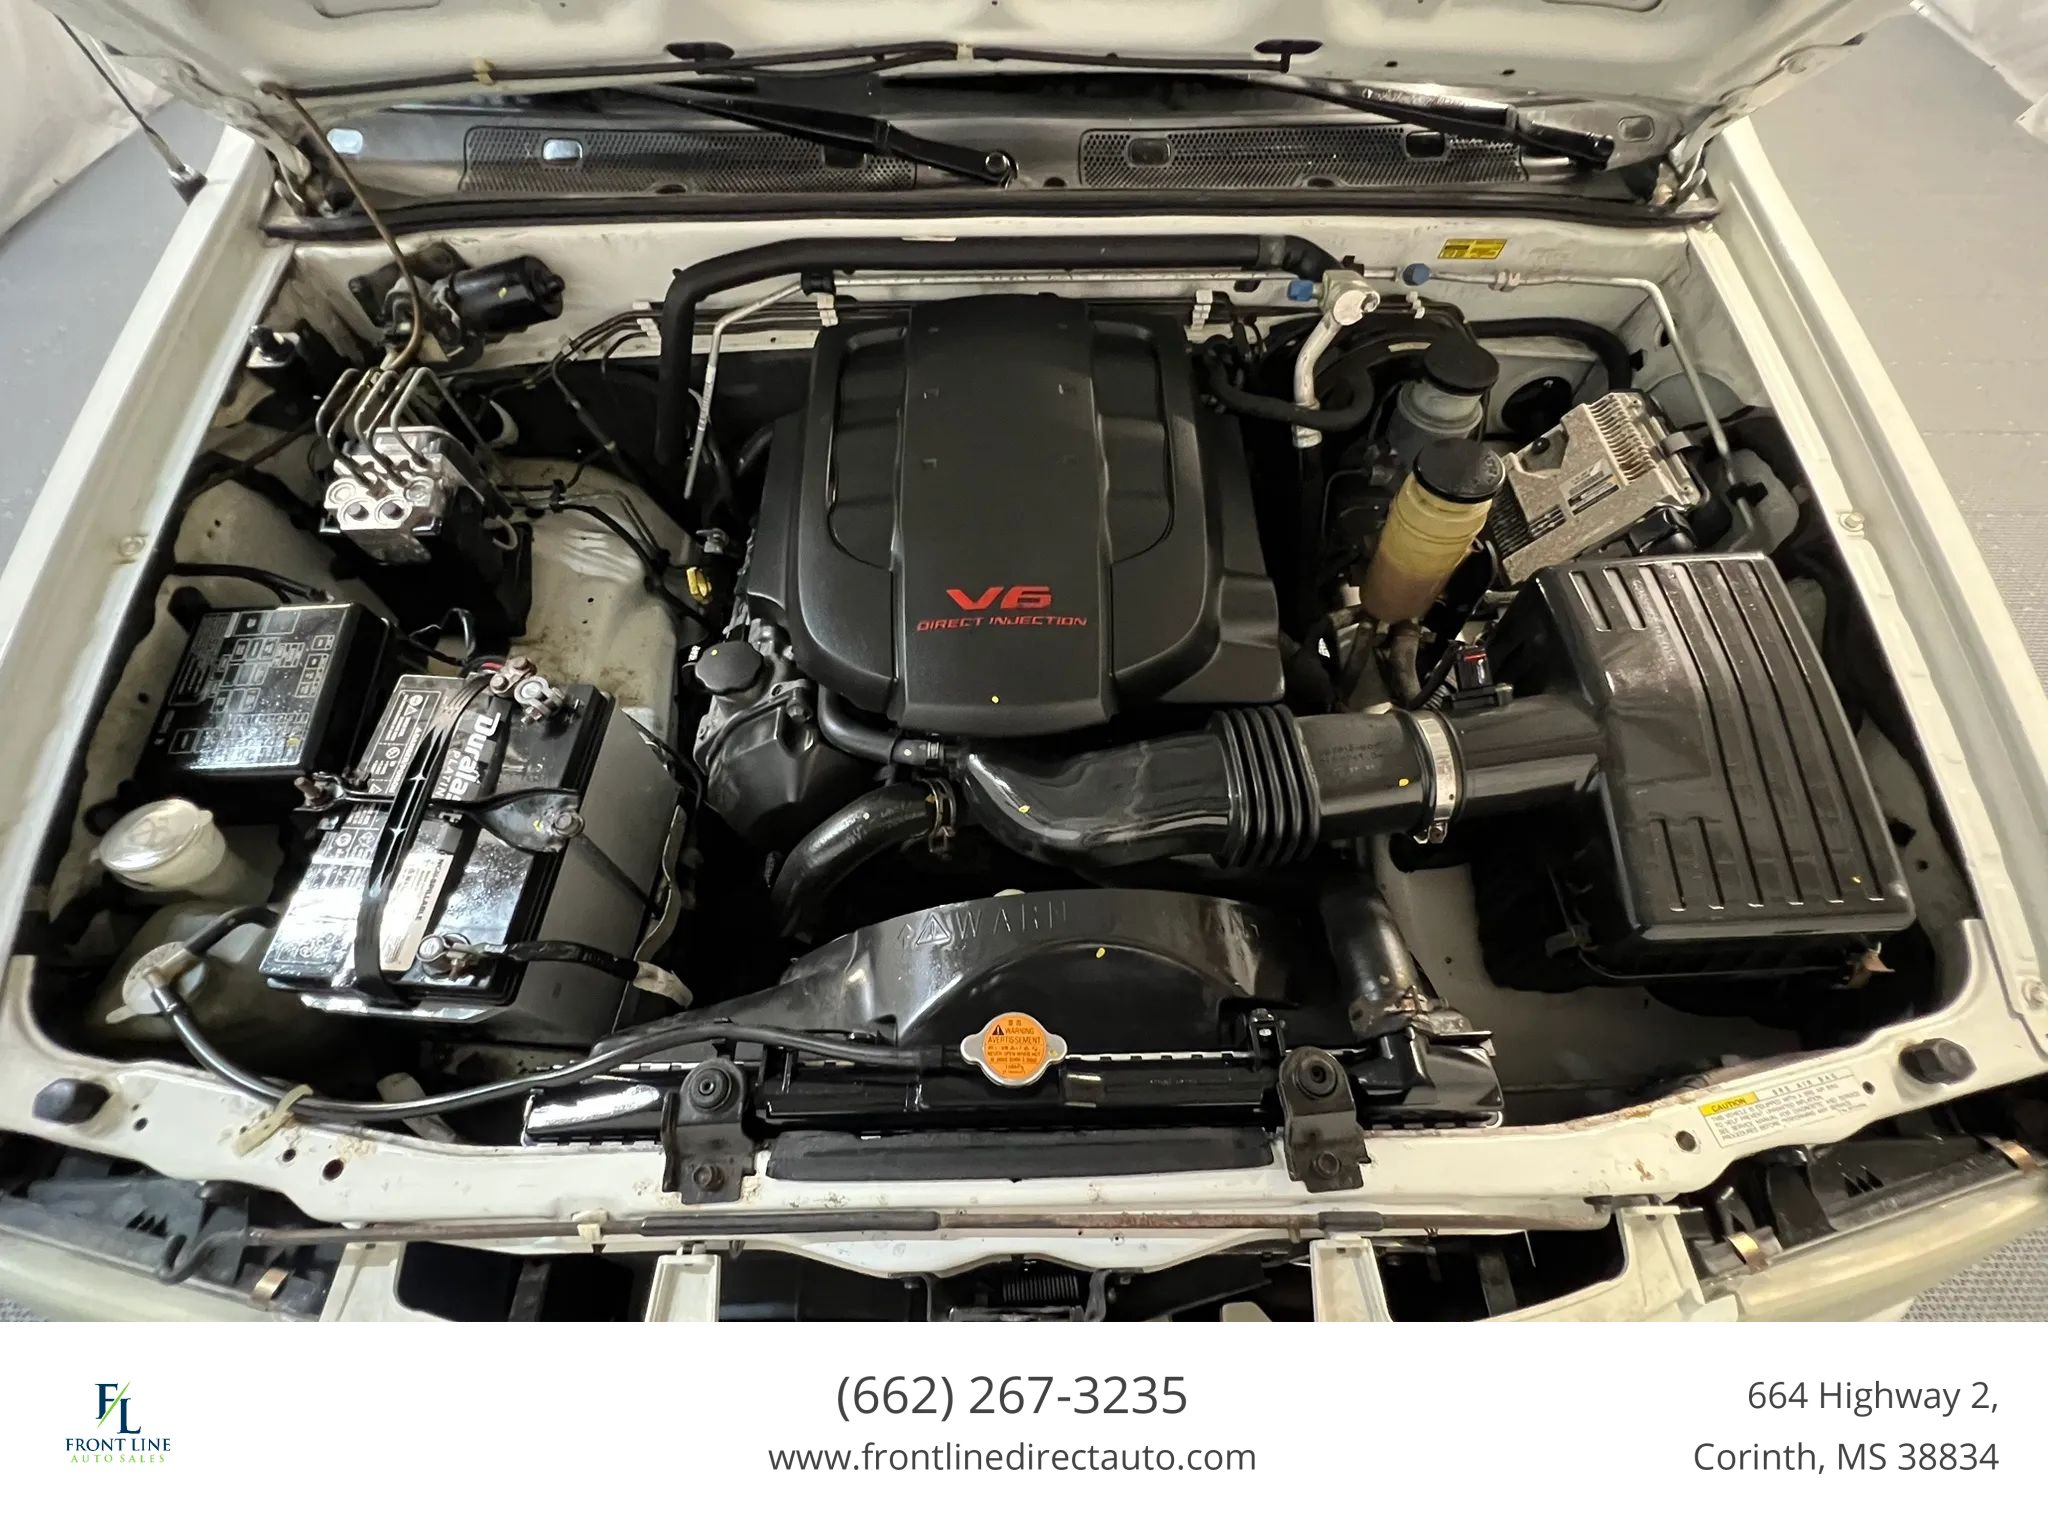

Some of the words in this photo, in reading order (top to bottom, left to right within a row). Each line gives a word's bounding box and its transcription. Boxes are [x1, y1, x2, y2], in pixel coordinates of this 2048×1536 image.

[946, 585, 1052, 611] V6
[916, 617, 985, 631] DIRECT
[989, 615, 1088, 627] INJECTION
[1005, 1027, 1035, 1035] WARNING
[988, 1035, 1041, 1044] AVERTISSEMENT
[1710, 1097, 1747, 1112] CAUTION
